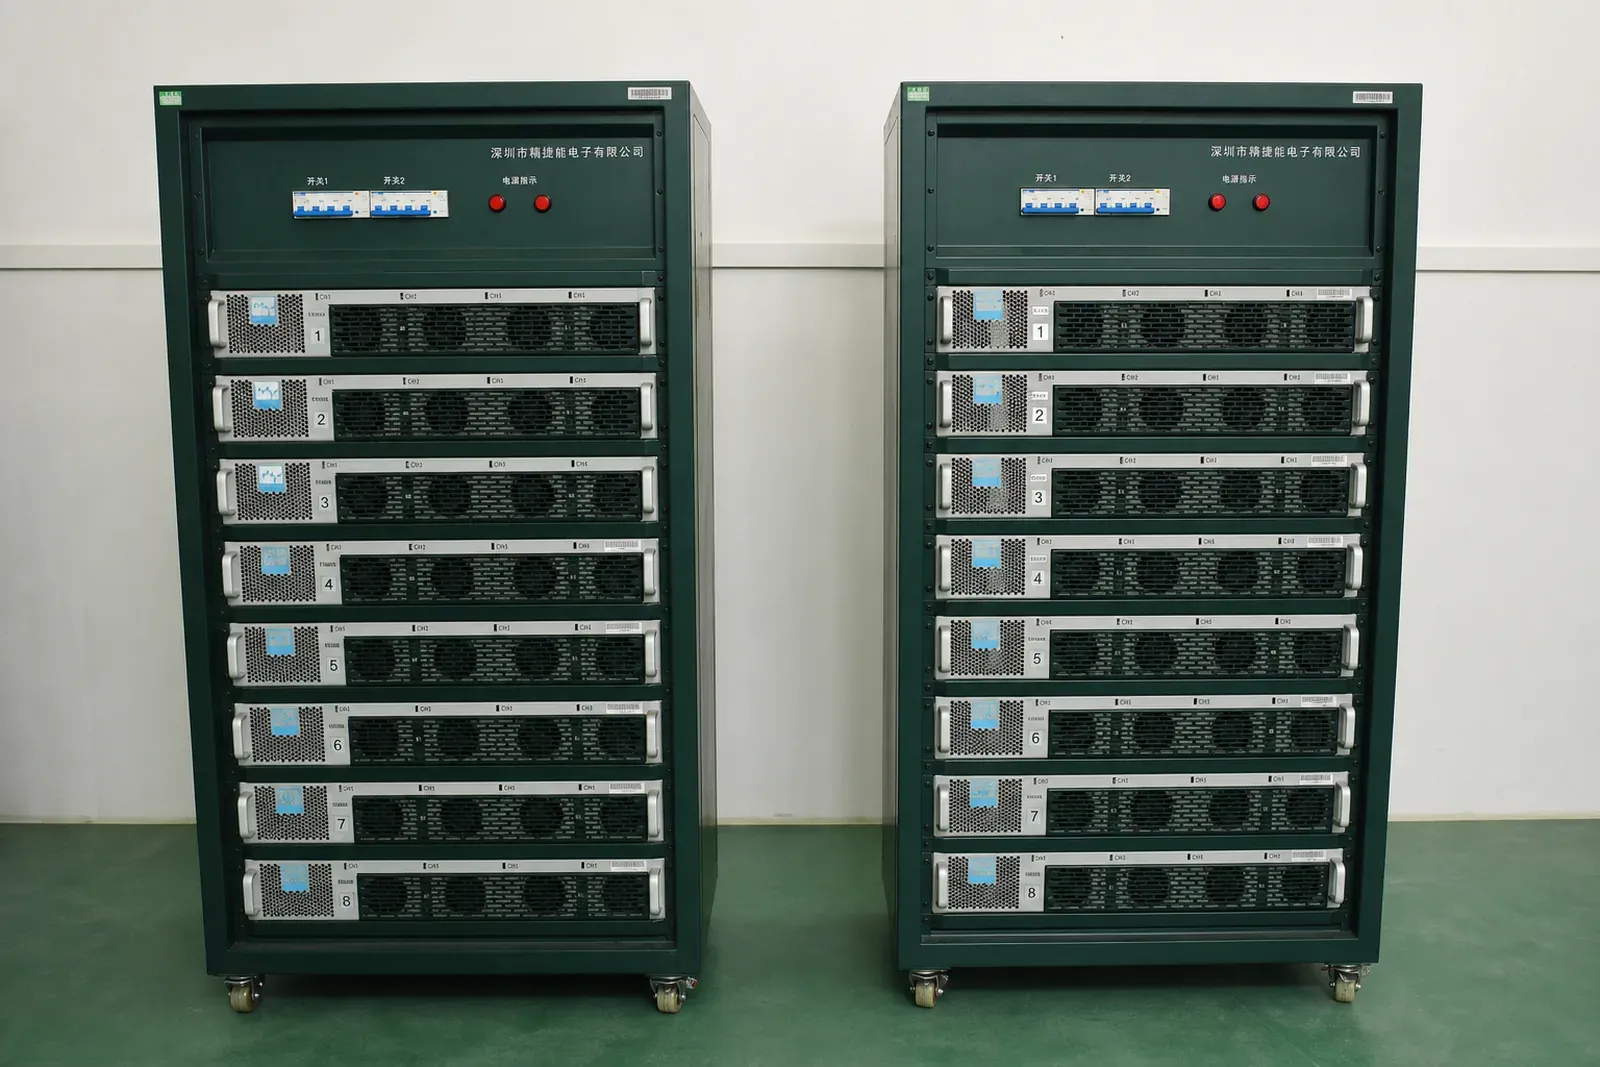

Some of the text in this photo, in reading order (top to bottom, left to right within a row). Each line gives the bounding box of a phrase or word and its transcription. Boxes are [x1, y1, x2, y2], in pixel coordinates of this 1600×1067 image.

[314, 330, 320, 342] 1
[1036, 326, 1044, 338] 1
[318, 414, 326, 426] 2
[1036, 410, 1044, 422] 2
[320, 496, 328, 508] 3
[1034, 492, 1042, 504] 3
[324, 578, 334, 590] 4
[1034, 572, 1042, 584] 4
[1034, 652, 1042, 664] 5
[330, 660, 338, 672] 5
[1032, 732, 1040, 744] 6
[334, 740, 342, 750] 6
[1030, 810, 1038, 822] 7
[336, 818, 346, 830] 7
[1028, 888, 1036, 898] 8
[342, 896, 352, 908] 8
